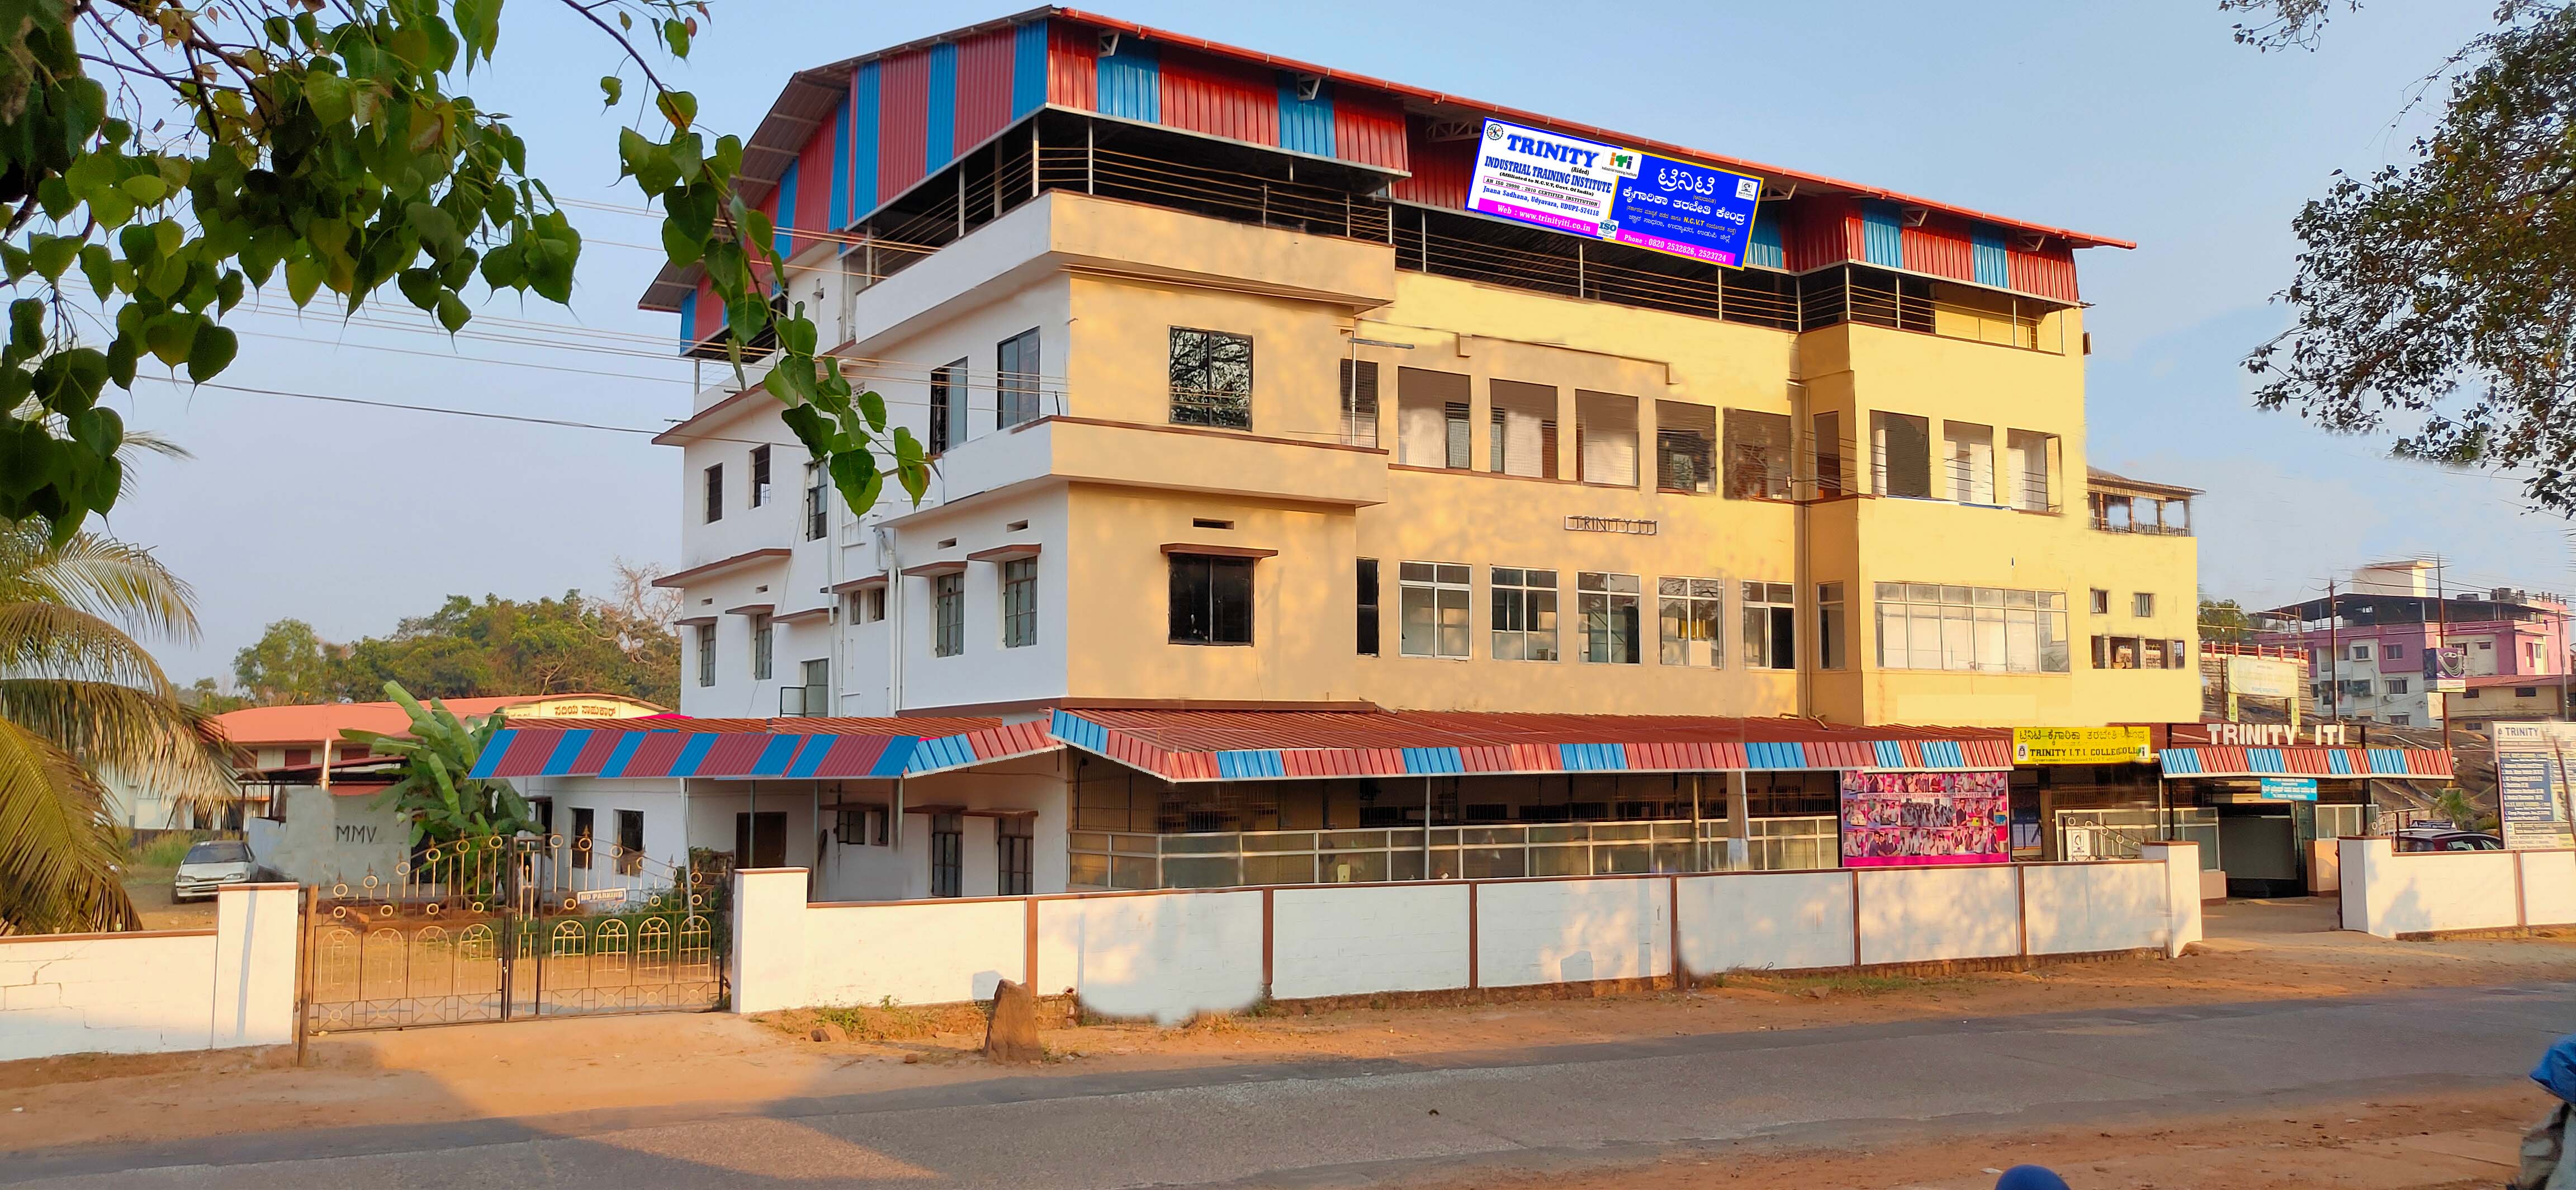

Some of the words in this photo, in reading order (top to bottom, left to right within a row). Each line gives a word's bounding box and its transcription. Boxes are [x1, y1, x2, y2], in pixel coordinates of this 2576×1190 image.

[1507, 134, 1599, 167] TRINITY
[1485, 156, 1531, 176] INDUSTRIAL
[1532, 166, 1570, 184] TRAINING
[1570, 175, 1612, 193] INSTITUTE
[1571, 167, 1589, 176] (Aided)
[1499, 172, 1527, 182] (Affiliated
[1535, 180, 1554, 188] N.C.V.T,
[1577, 188, 1594, 197] India)
[1483, 186, 1500, 195] Jnana
[1503, 190, 1529, 202] Sadhana,
[1531, 196, 1559, 209] Udyavara,
[1560, 202, 1599, 216] UDUPI-574118
[1538, 190, 1564, 199] CERTIFIED
[1565, 196, 1598, 206] INSTITUTION
[1623, 186, 1668, 205] ಕೈಗಾರಿಕಾ
[1673, 200, 1711, 215] ತರಬೇತಿ
[1716, 207, 1745, 225] ಕೇಂದ್ರ
[1498, 205, 1512, 214] Web
[1519, 211, 1591, 232] www.trinityiti.co.in
[1599, 222, 1617, 232] ISO
[1683, 216, 1705, 226] N.C.V.T
[1624, 234, 1642, 244] Phone
[1649, 238, 1664, 248] 0820
[1666, 243, 1697, 257] 2532826,
[1698, 249, 1726, 262] 2523724
[1568, 516, 1631, 532] TRINITY
[1638, 520, 1657, 534] ITI
[2206, 724, 2297, 745] TRINITY
[2315, 724, 2345, 745] ITI
[2505, 727, 2538, 736] TRINITY
[336, 825, 377, 843] MMV
[593, 891, 623, 900] PARKING
